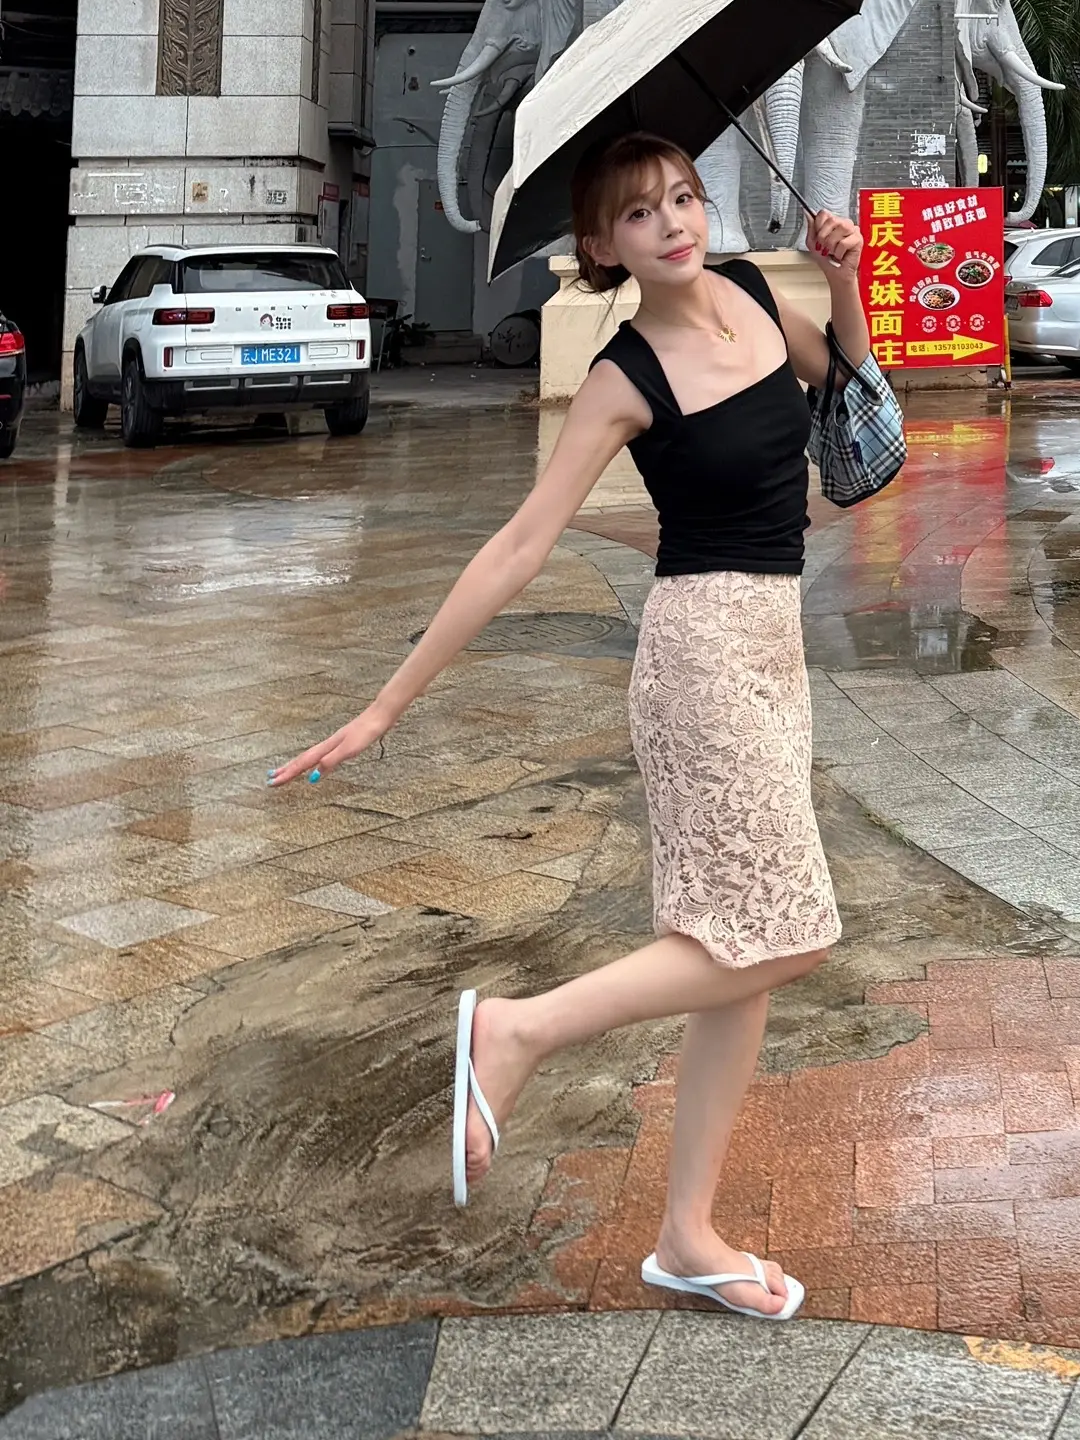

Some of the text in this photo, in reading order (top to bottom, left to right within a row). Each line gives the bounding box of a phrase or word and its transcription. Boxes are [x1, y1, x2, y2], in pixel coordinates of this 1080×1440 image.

[921, 194, 978, 221] 精选好食材
[930, 207, 987, 233] 精致重庆面
[868, 192, 904, 365] 重庆幺妹面庄
